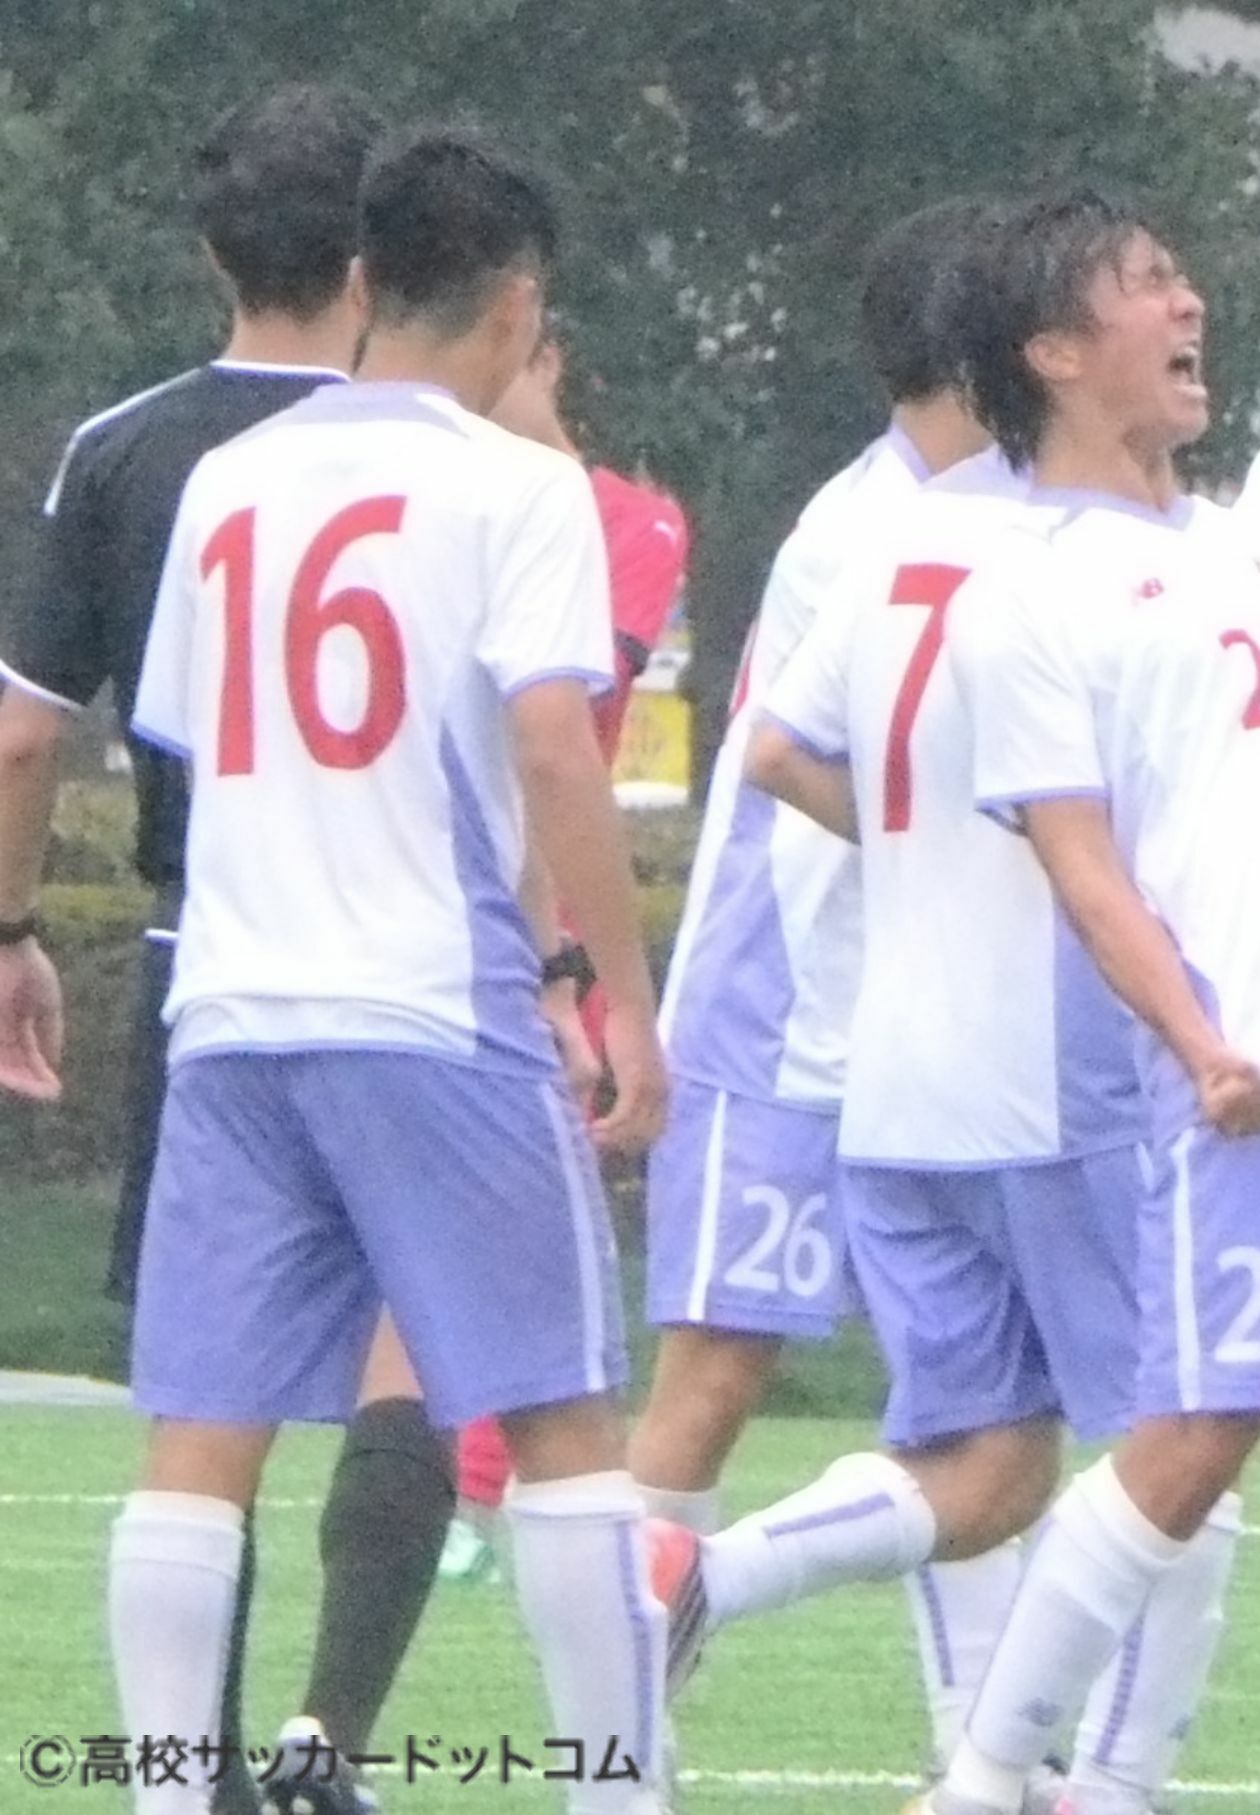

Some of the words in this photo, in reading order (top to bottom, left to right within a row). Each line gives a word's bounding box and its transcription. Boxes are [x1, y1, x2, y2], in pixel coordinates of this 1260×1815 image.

[201, 494, 407, 775] 16
[884, 563, 972, 832] 7
[723, 1184, 832, 1298] 26
